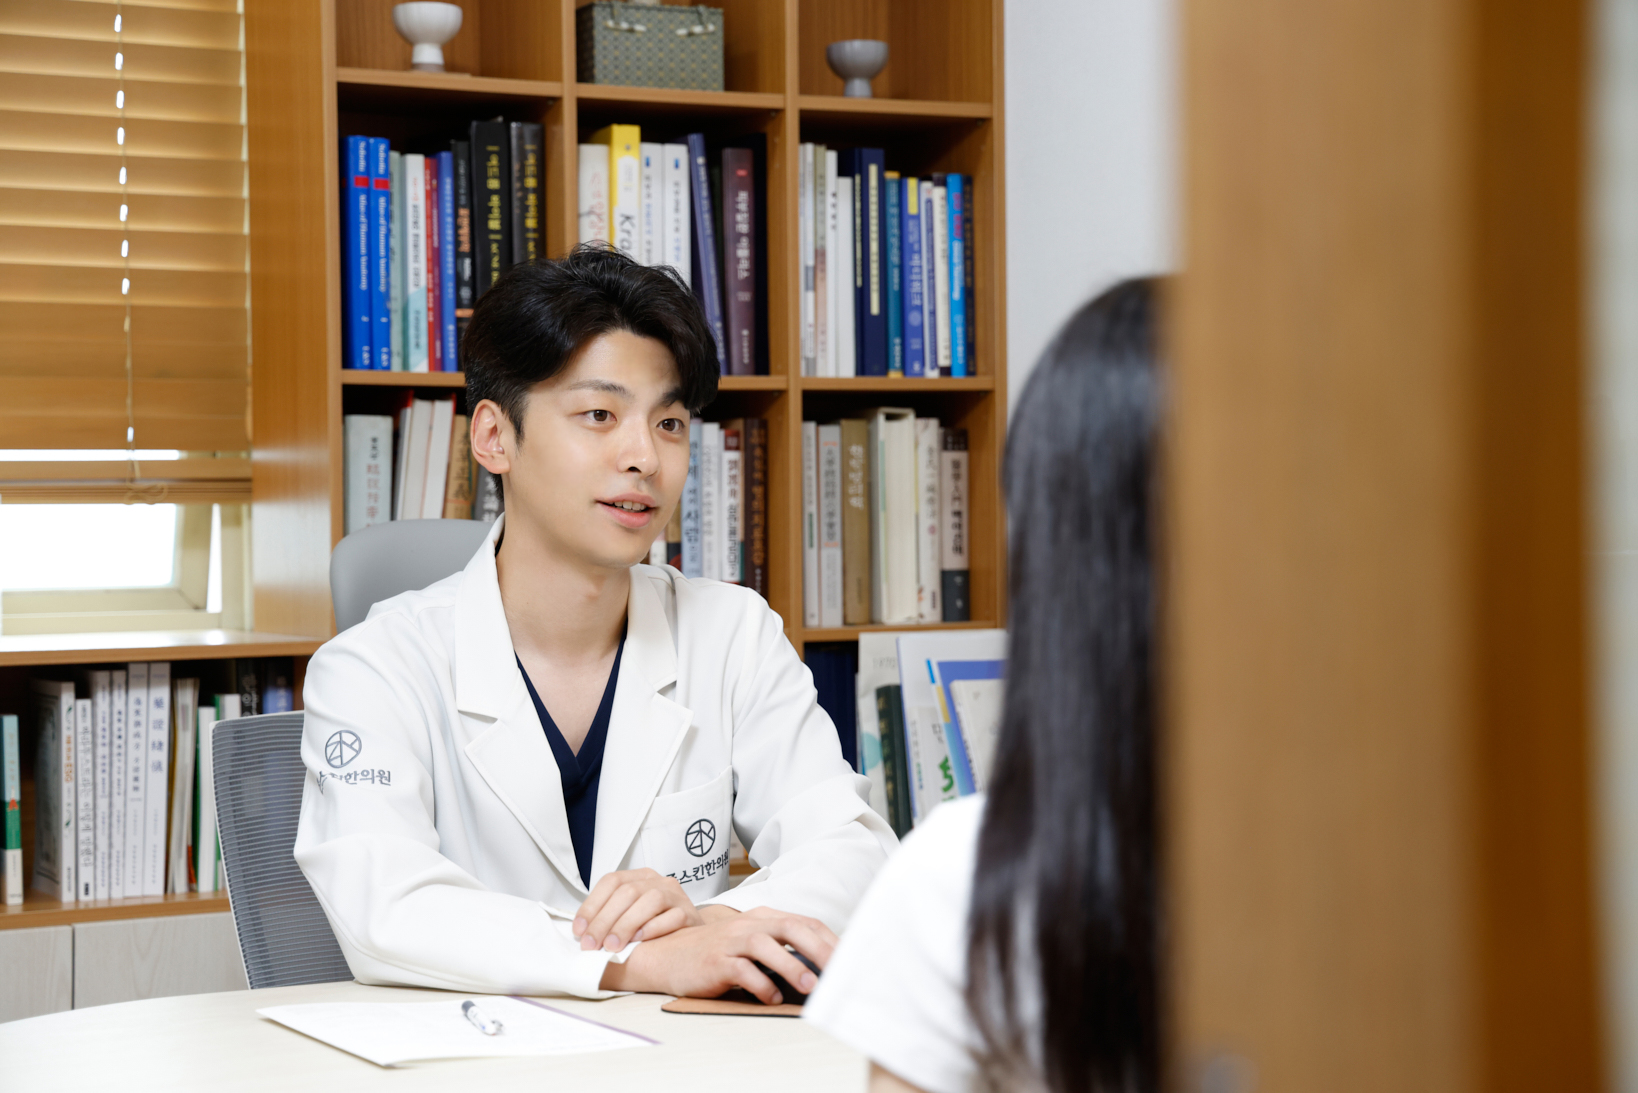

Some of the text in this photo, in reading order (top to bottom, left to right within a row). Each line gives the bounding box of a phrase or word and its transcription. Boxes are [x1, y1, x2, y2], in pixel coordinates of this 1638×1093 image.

[486, 154, 501, 231] 여드름 바이블
[524, 153, 538, 229] 여드름 바이블
[736, 190, 750, 234] 피부질환
[618, 212, 636, 250] Kra
